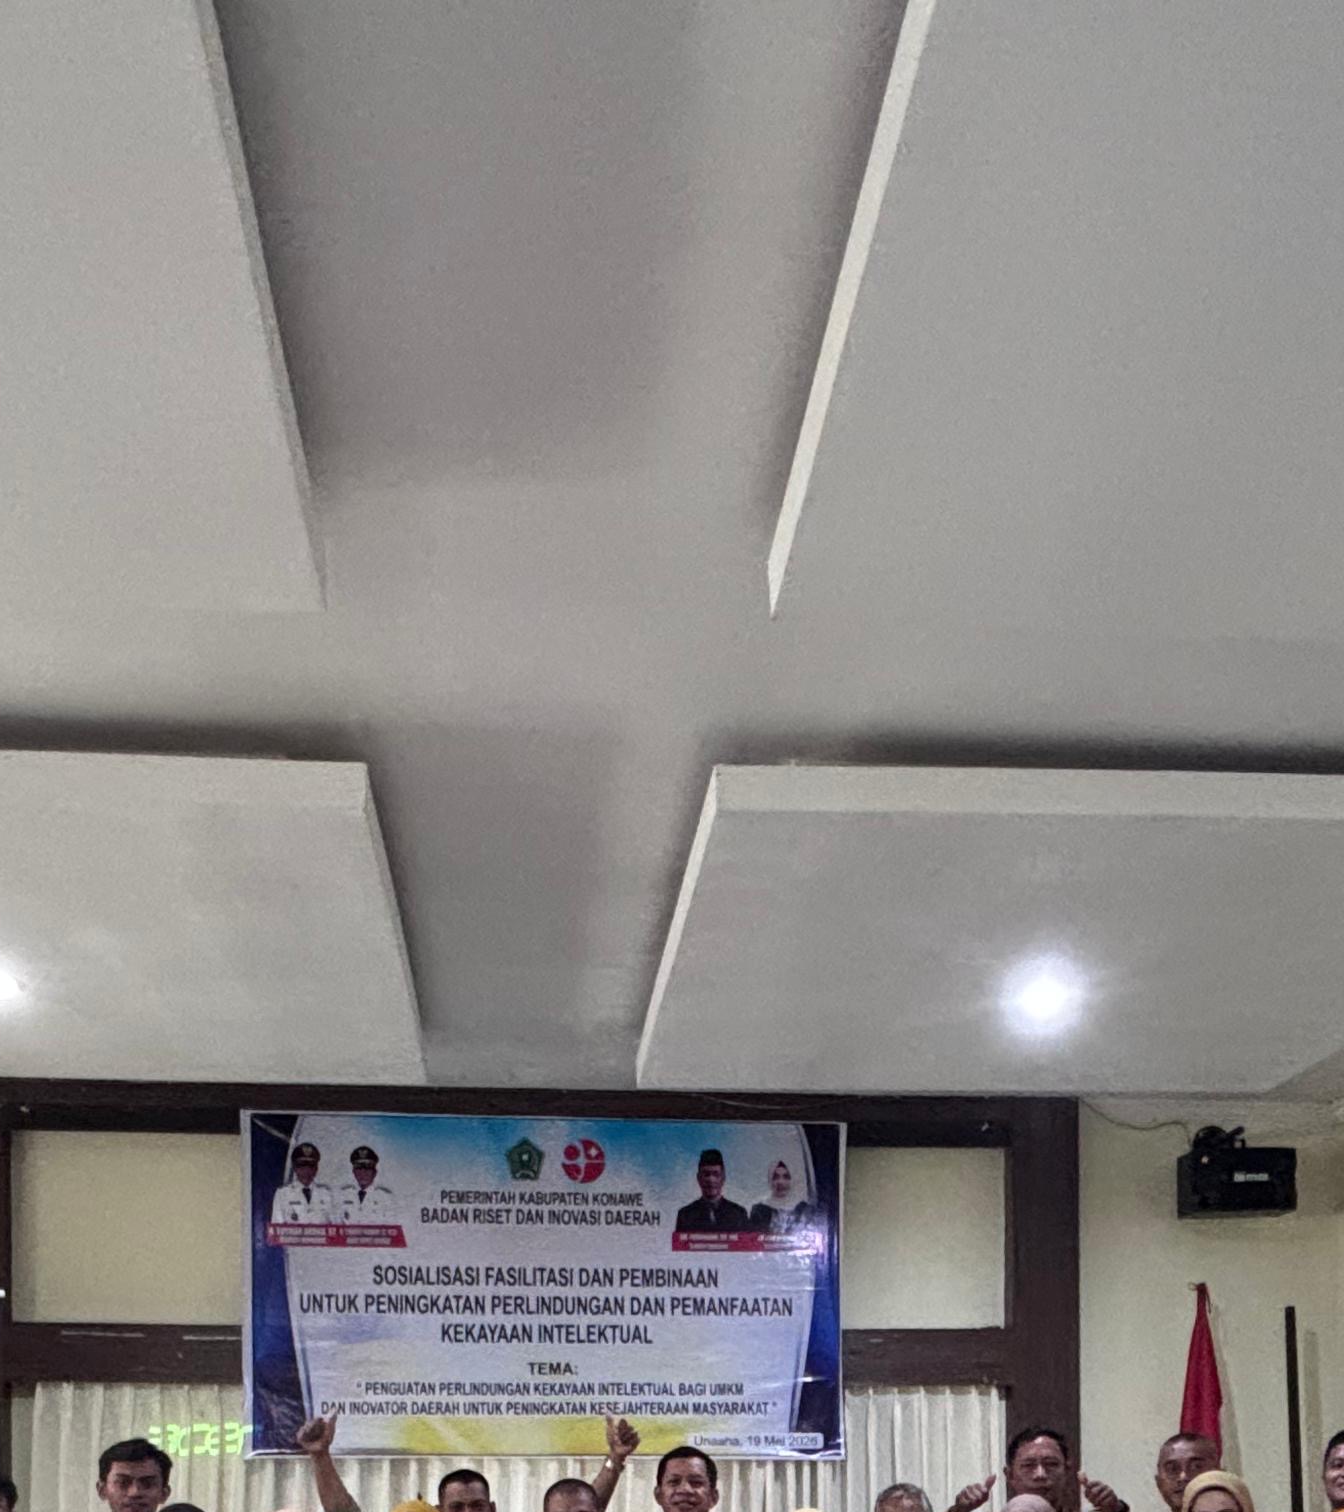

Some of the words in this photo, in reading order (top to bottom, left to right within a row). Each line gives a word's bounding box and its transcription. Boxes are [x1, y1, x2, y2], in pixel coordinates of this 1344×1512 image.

[440, 1190, 516, 1205] PEMERINTAH
[519, 1191, 589, 1206] KABUPATEN
[592, 1192, 644, 1207] KONAWE
[420, 1207, 468, 1224] BADAN
[473, 1208, 512, 1225] RISET
[516, 1209, 545, 1225] DAN
[548, 1210, 601, 1226] INOVASI
[605, 1210, 661, 1227] DAERAH
[372, 1265, 480, 1286] SOSIALISASI
[485, 1266, 574, 1287] FASILITASI
[579, 1268, 614, 1287] DAN
[620, 1268, 719, 1288] PEMBINAAN
[299, 1294, 359, 1314] UNTUK
[365, 1295, 486, 1315] PENINGKATAN
[491, 1296, 625, 1316] PERLINDUNGAN
[631, 1297, 665, 1317] DAN
[671, 1297, 793, 1318] PEMANFAATAN
[441, 1323, 533, 1344] KEKAYAAN
[538, 1324, 654, 1345] INTELEKTUAL
[528, 1362, 579, 1377] TEMA:
[365, 1382, 435, 1396] PENGUATAN
[439, 1382, 530, 1396] PERLINDUNGAN
[533, 1382, 594, 1397] KEKAYAAN
[598, 1382, 674, 1396] INTELEKTUAL
[678, 1383, 706, 1396] BAGI
[709, 1383, 744, 1396] UMKM
[349, 1402, 408, 1416] INOVATOR
[411, 1402, 459, 1416] DAERAH
[463, 1402, 503, 1416] UNTUK
[507, 1402, 587, 1416] PENINGKATAN
[590, 1402, 689, 1417] KESEJAHTERAAN
[692, 1402, 768, 1417] MASYARAKAT
[747, 1435, 762, 1446] 19
[764, 1435, 785, 1446] Mei
